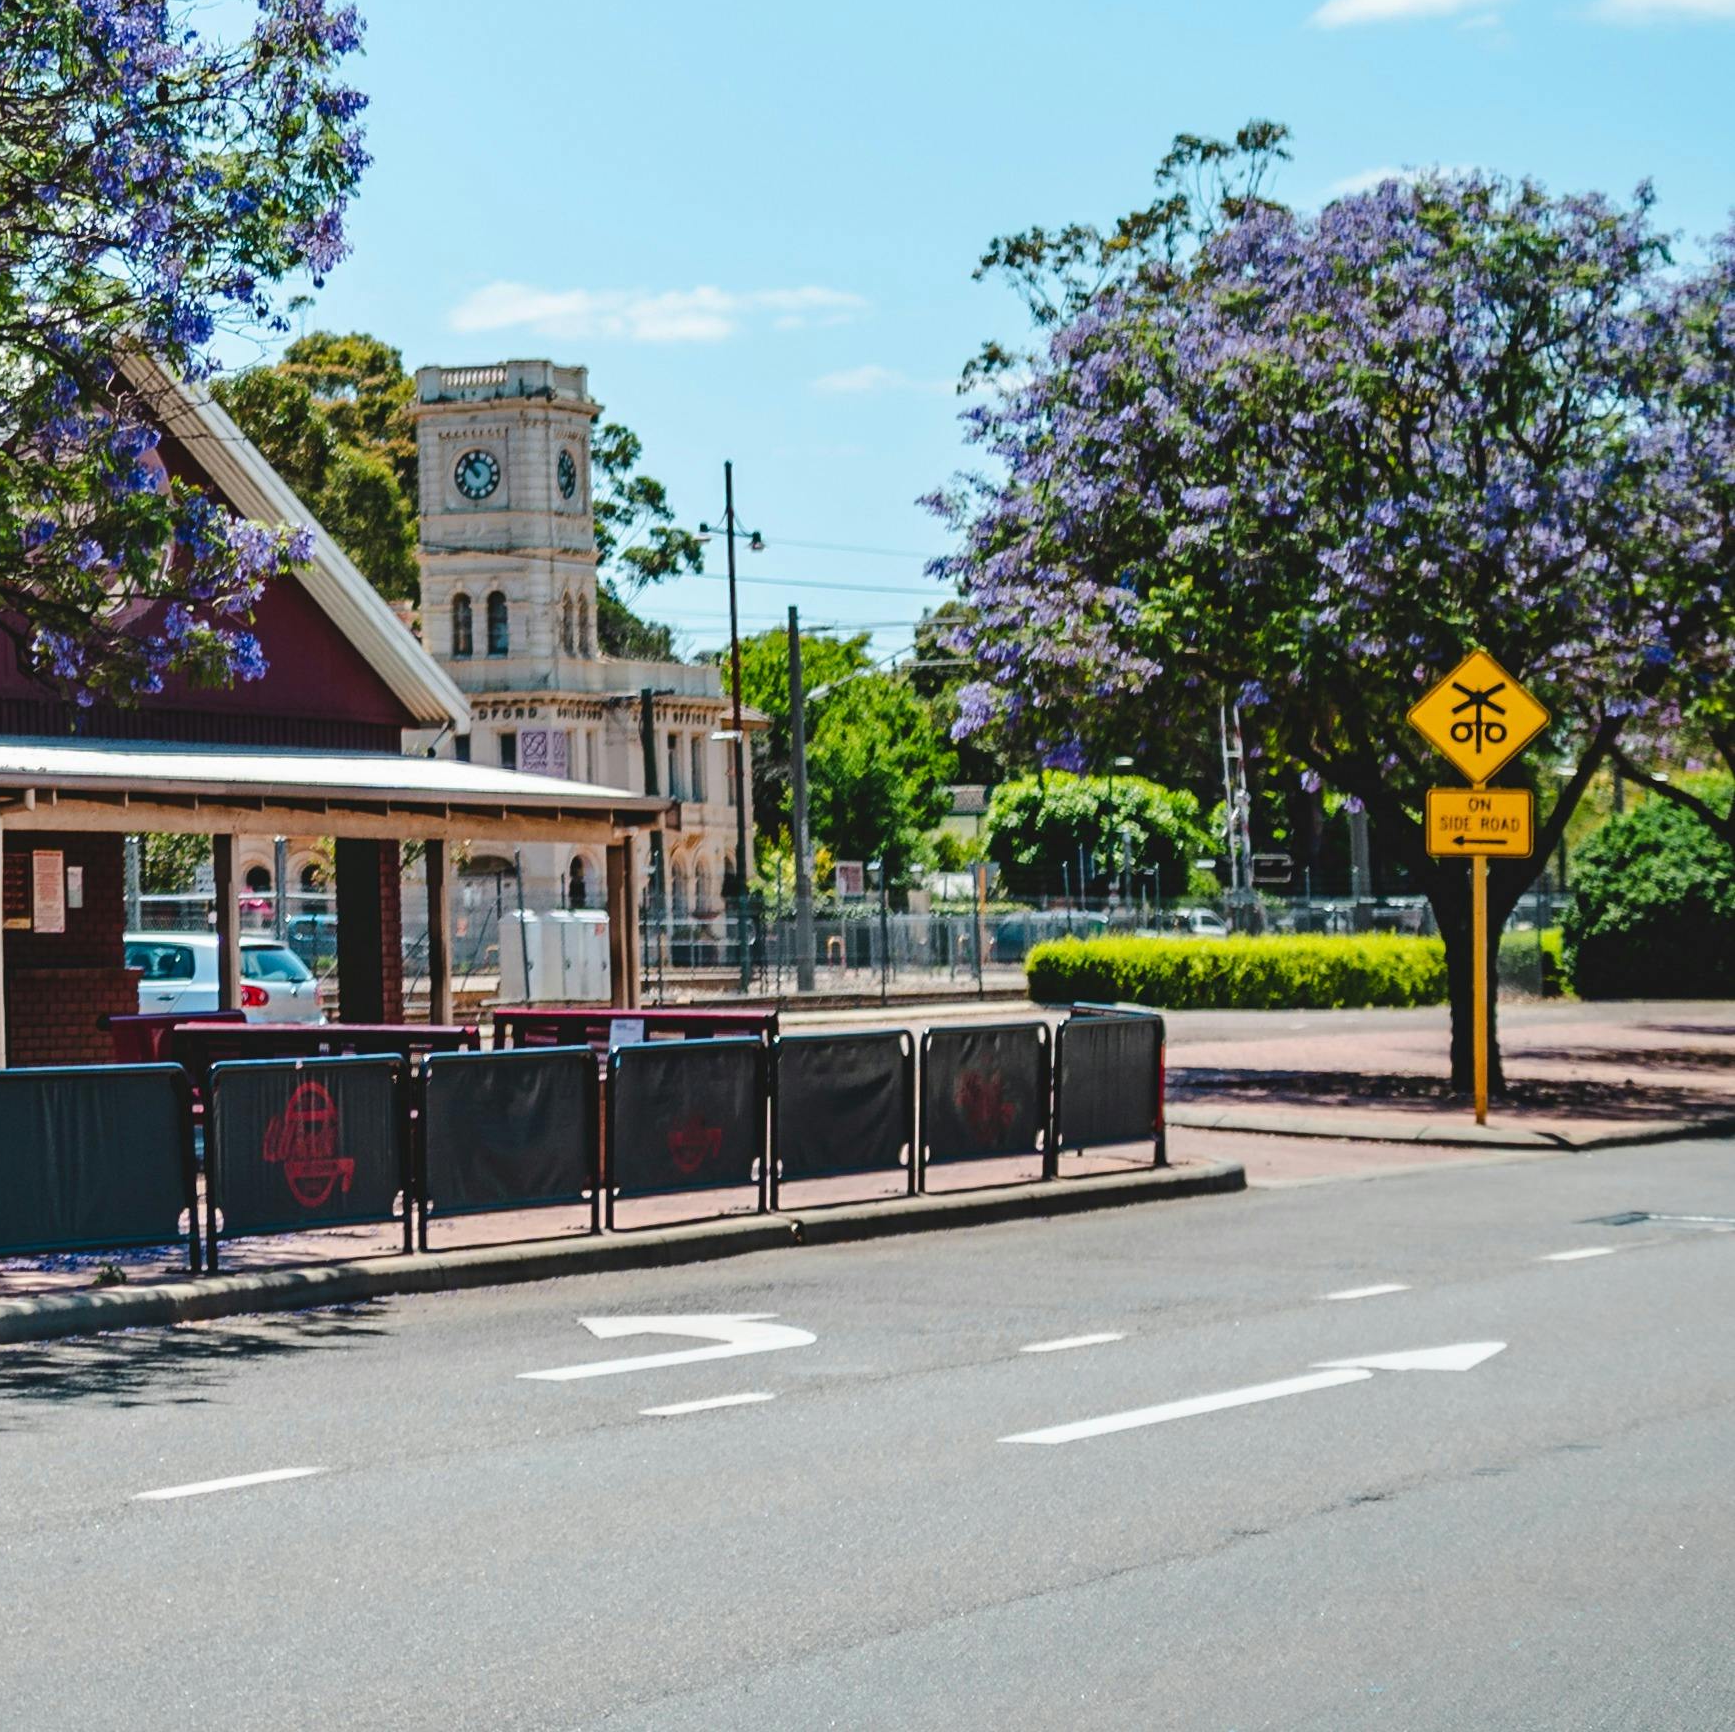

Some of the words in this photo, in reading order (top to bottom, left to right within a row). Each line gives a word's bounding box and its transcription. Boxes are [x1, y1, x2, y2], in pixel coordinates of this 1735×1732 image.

[1467, 797, 1492, 812] ON
[1439, 814, 1472, 831] SIDE
[1480, 815, 1521, 833] ROAD
